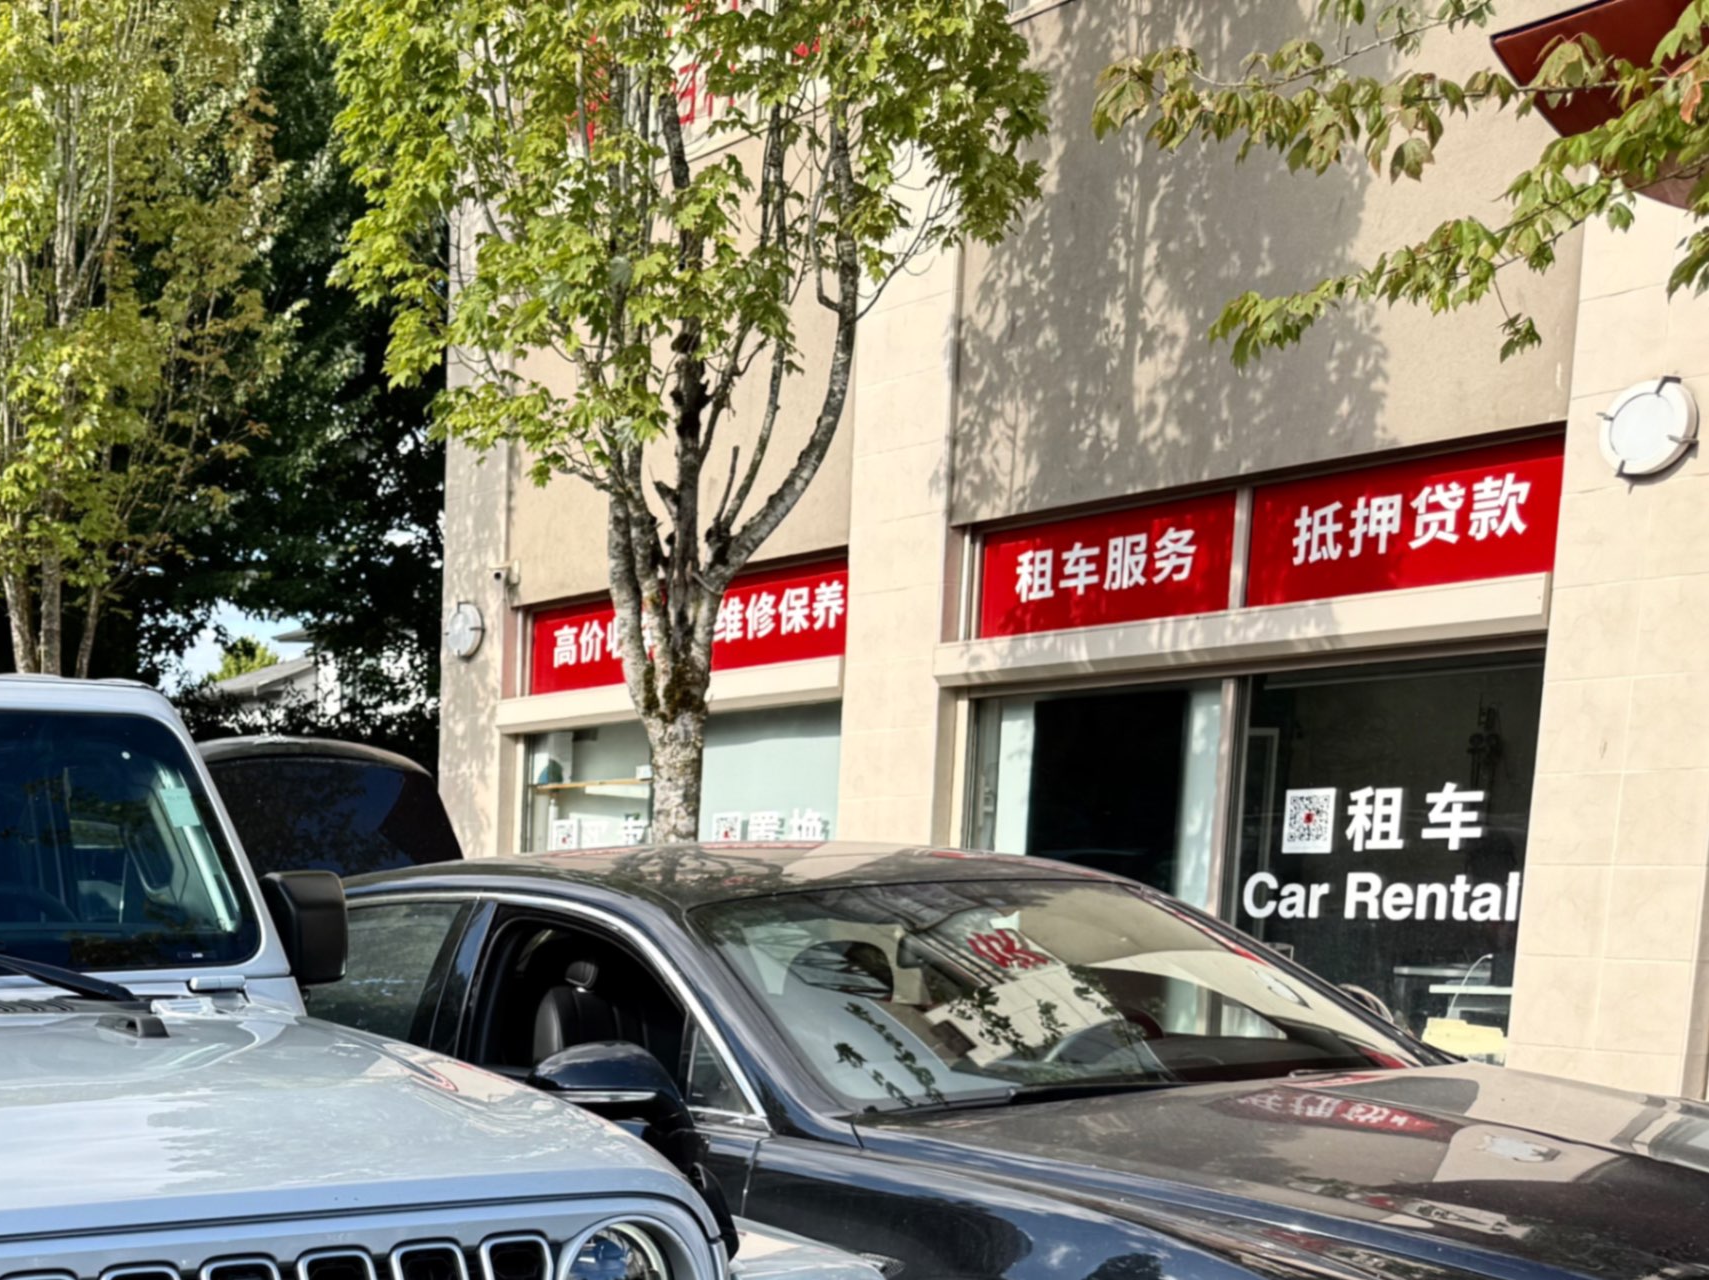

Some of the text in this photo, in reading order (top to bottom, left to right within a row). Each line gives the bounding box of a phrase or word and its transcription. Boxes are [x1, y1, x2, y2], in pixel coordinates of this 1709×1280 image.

[1292, 472, 1531, 566] 抵押贷款
[1014, 526, 1197, 603] 租车服务
[713, 580, 845, 643] 维修保养
[1345, 782, 1485, 852] 租车
[1243, 871, 1521, 922] Car Rental
